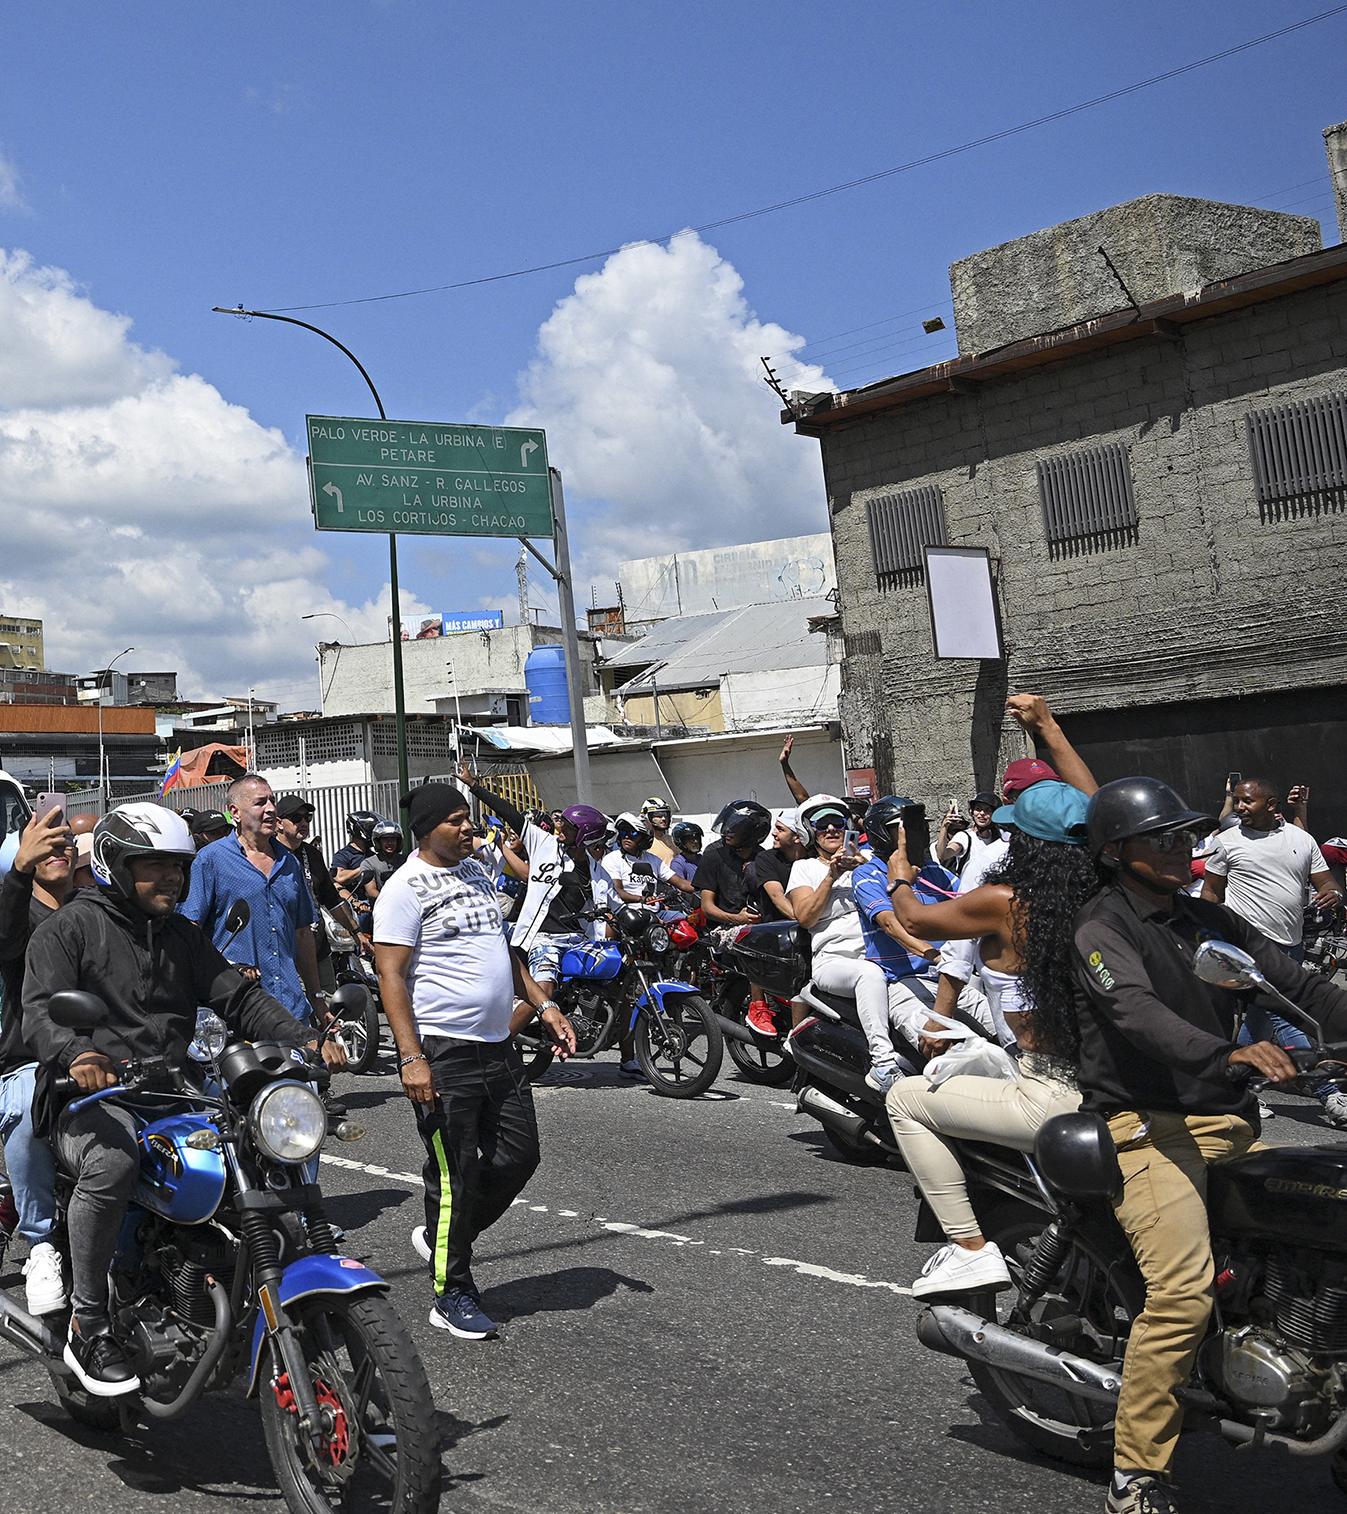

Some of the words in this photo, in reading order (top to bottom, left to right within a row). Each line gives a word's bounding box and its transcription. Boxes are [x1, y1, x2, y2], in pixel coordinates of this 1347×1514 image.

[311, 426, 345, 440] PALO
[351, 429, 397, 443] VERDE
[409, 432, 429, 445] LA
[435, 434, 486, 448] URBINA
[380, 449, 436, 463] PETARE
[355, 474, 376, 487] AV.
[381, 475, 419, 488] SANZ
[436, 478, 449, 490] R.
[455, 479, 526, 493] GALLEGOS
[403, 493, 422, 506] LA
[431, 495, 483, 509] URBINA
[358, 510, 385, 522] LOS
[393, 511, 457, 526] CORTIJOS
[471, 514, 526, 528] CHACAO
[445, 619, 461, 631] MÁS
[462, 618, 494, 630] CAMBIOS
[494, 618, 500, 628] Y
